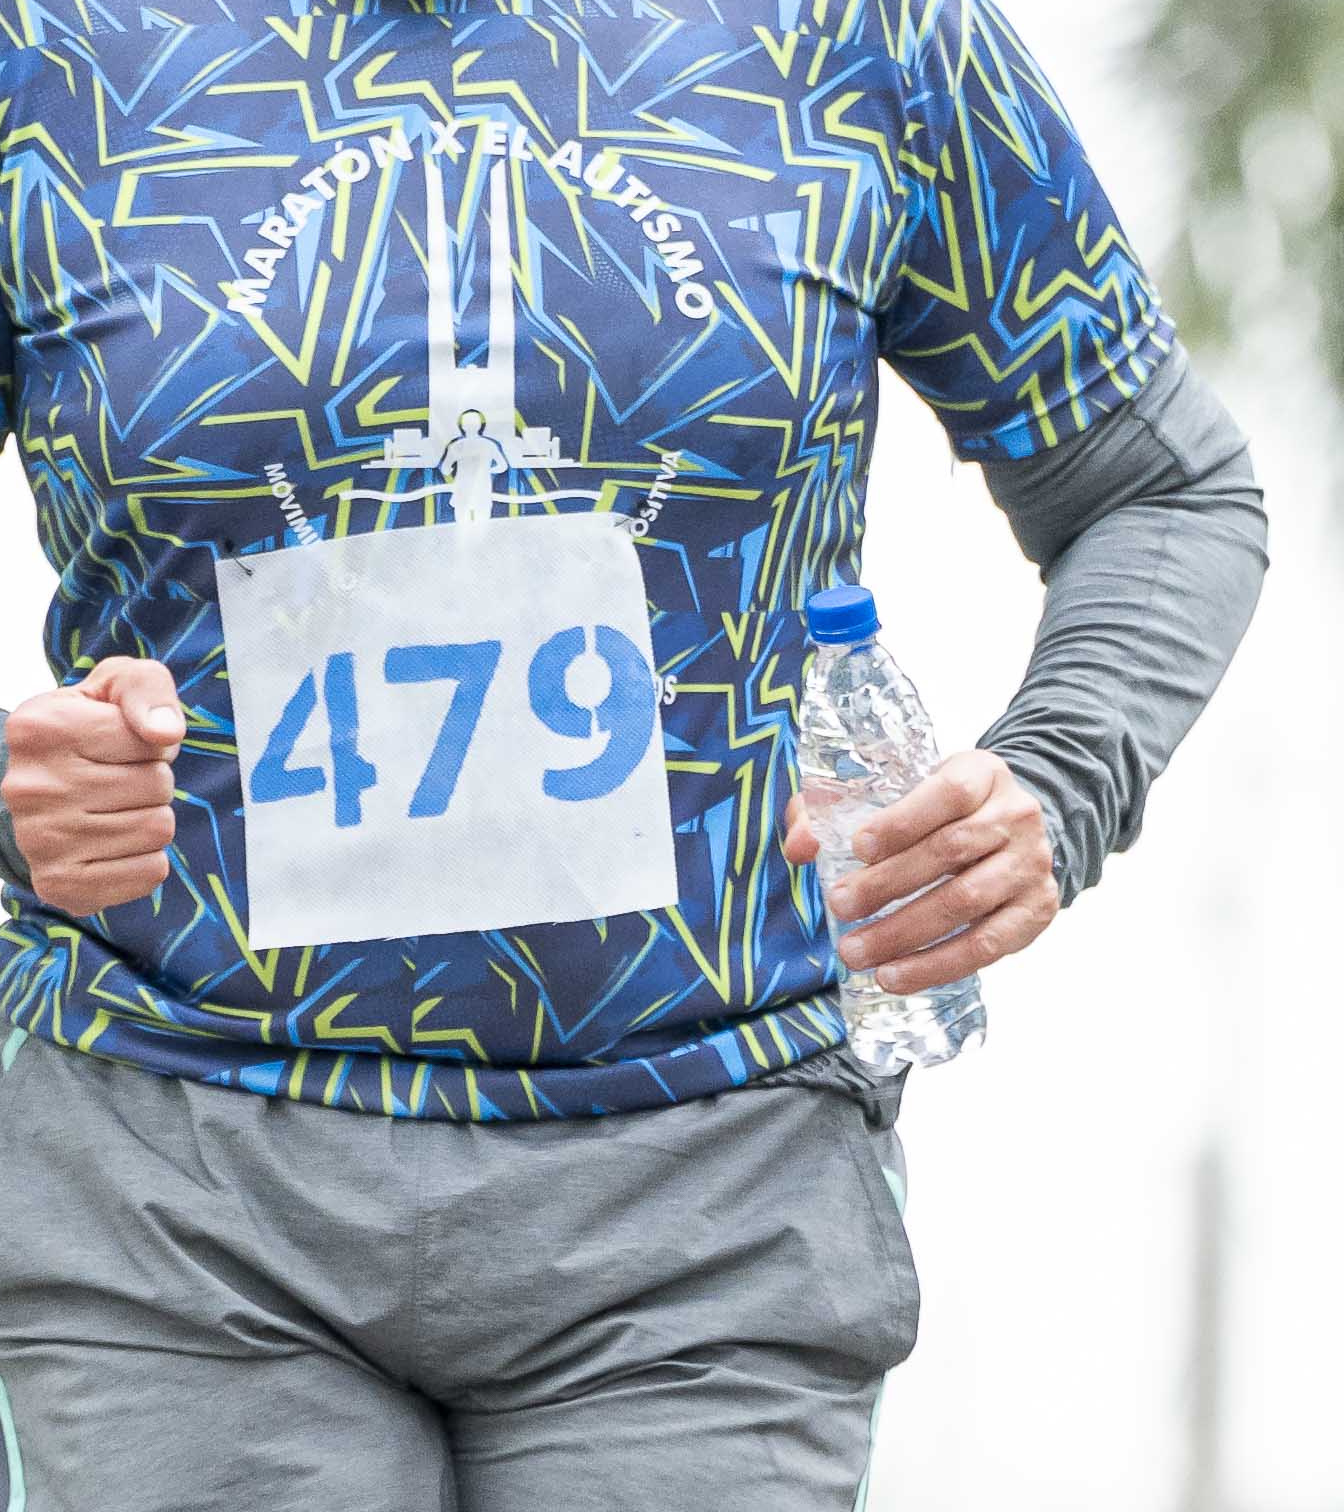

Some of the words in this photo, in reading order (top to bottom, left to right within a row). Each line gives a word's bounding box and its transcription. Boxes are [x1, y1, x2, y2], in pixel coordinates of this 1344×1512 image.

[227, 128, 414, 320] MARATÓN
[429, 119, 466, 155] X
[483, 120, 533, 162] EL
[547, 139, 714, 319] AUTISMO
[630, 451, 683, 538] OSITIVA
[249, 624, 656, 828] 479
